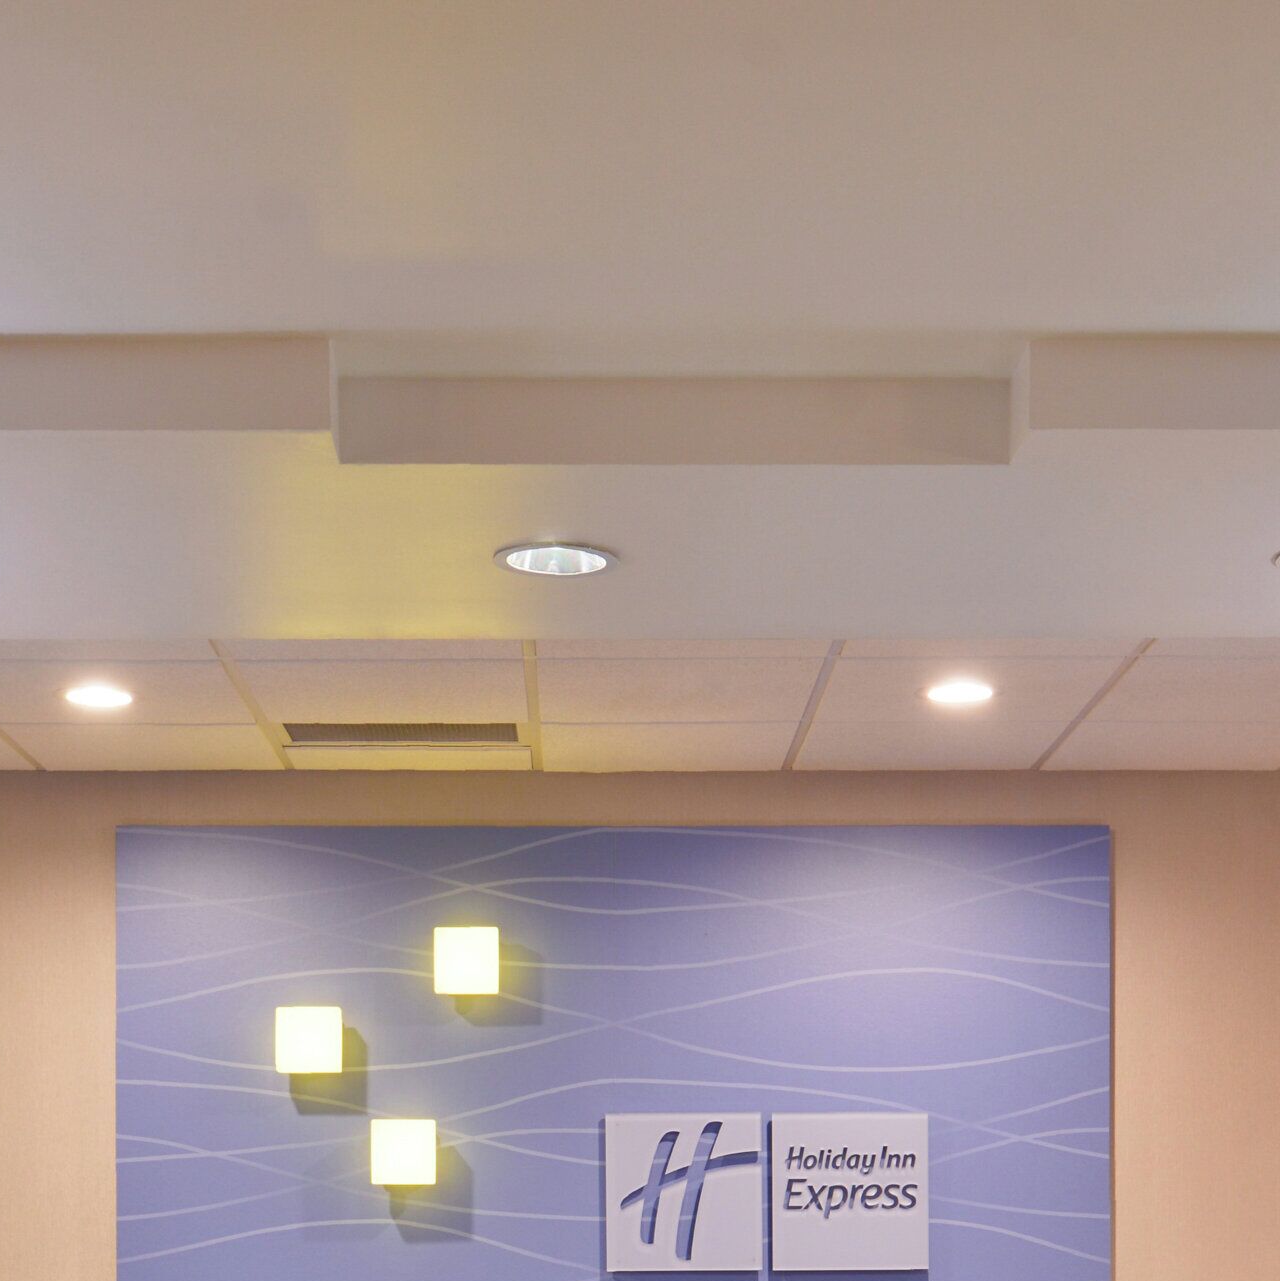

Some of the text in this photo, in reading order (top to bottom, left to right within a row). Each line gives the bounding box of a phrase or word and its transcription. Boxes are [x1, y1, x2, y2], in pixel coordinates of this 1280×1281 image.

[785, 1145, 916, 1175] Holiday Inn
[784, 1178, 918, 1219] Express
